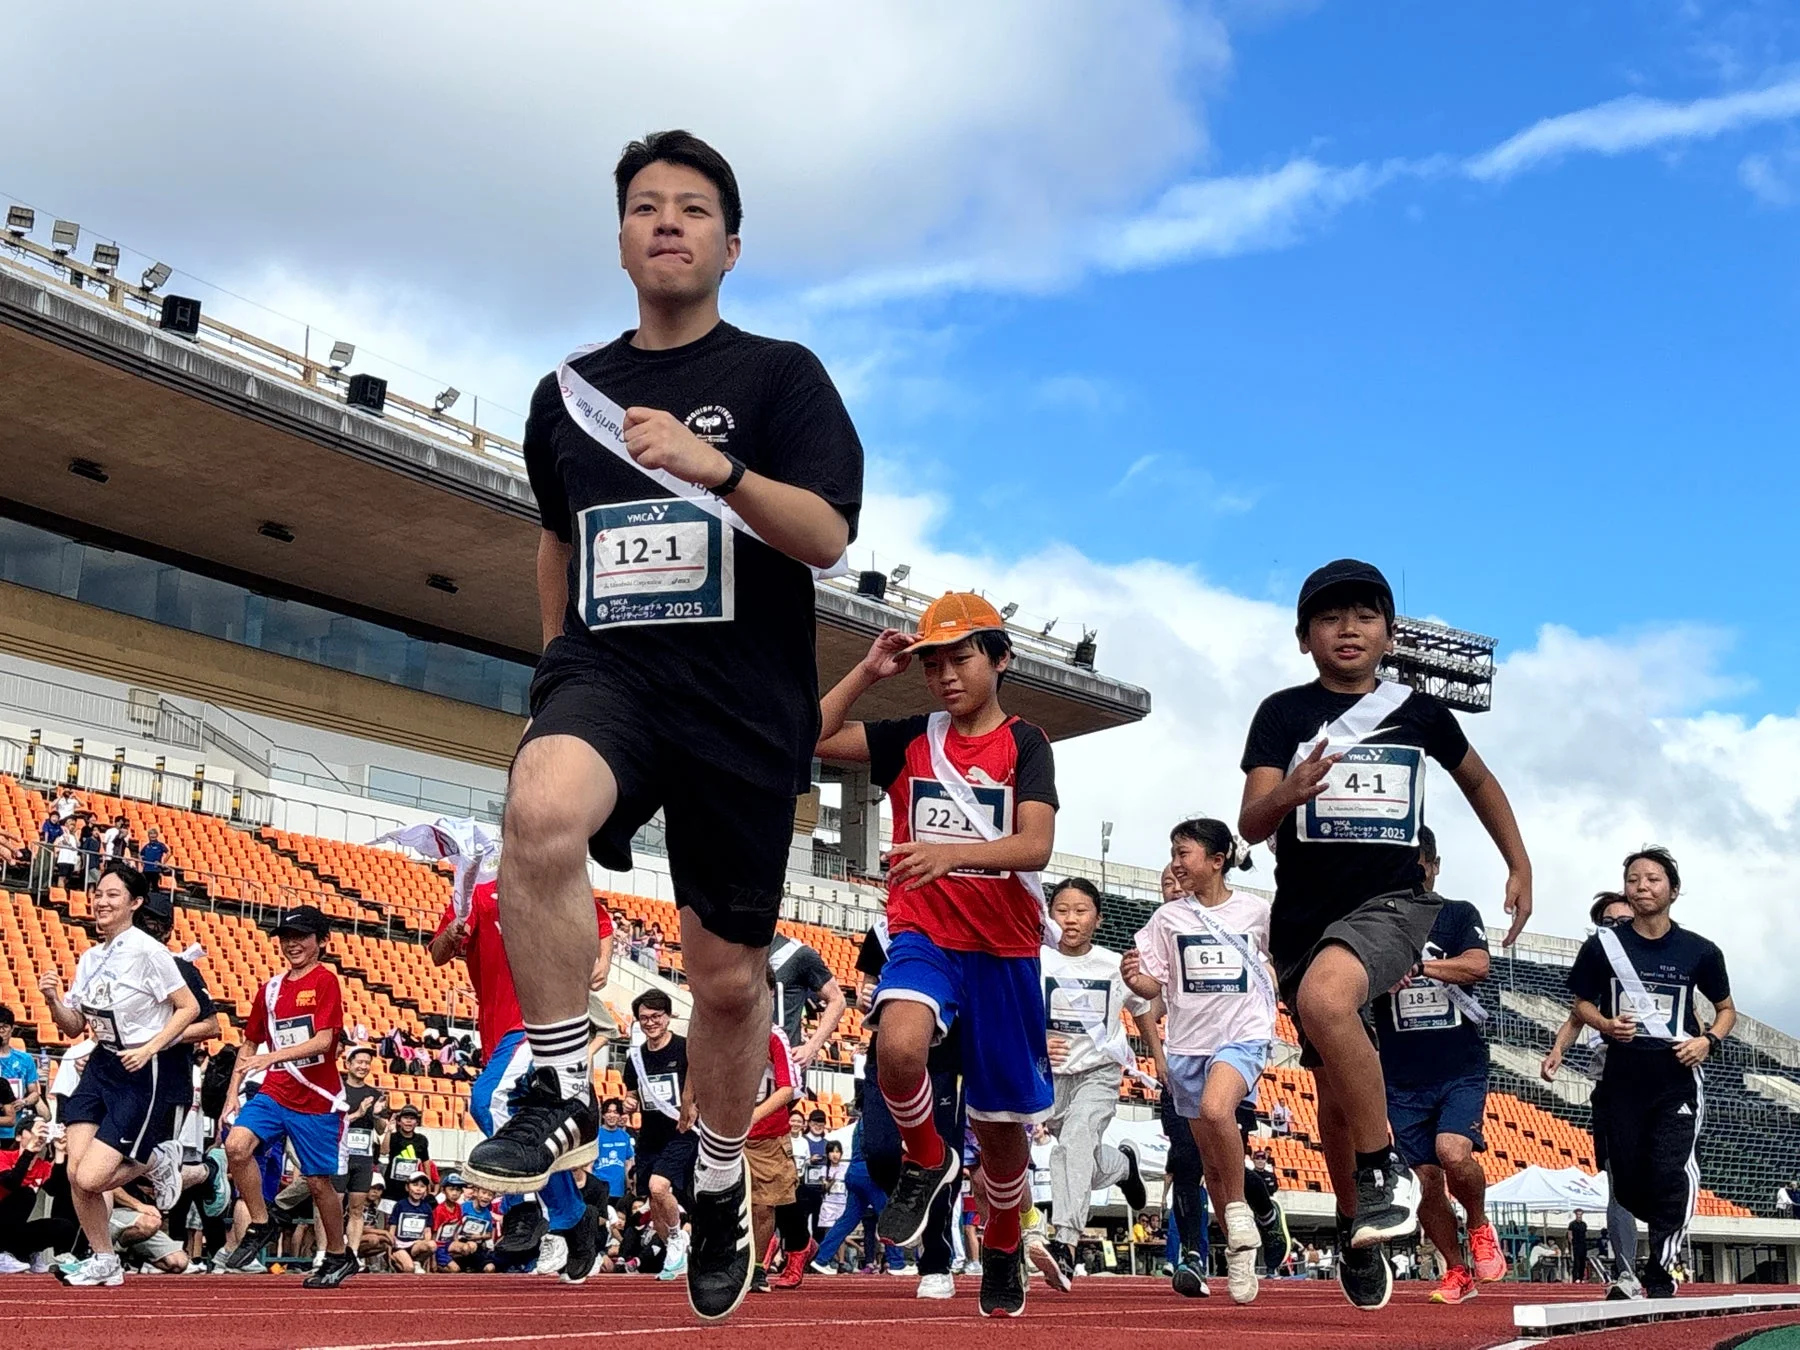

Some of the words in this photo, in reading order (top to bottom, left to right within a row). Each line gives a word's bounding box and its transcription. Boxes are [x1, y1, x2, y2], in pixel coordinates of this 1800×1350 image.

[576, 398, 593, 417] Run
[684, 406, 713, 426] ANQUISH
[714, 406, 735, 429] FITNESS
[593, 410, 625, 443] harity
[627, 512, 654, 523] YMCA
[615, 536, 682, 565] 12-1
[664, 602, 702, 617] 2025
[1345, 772, 1386, 794] 4-1
[1380, 827, 1405, 839] 2025
[1200, 951, 1225, 964] 6-1
[1222, 984, 1240, 992] 2025
[1408, 992, 1438, 1004] 18-1
